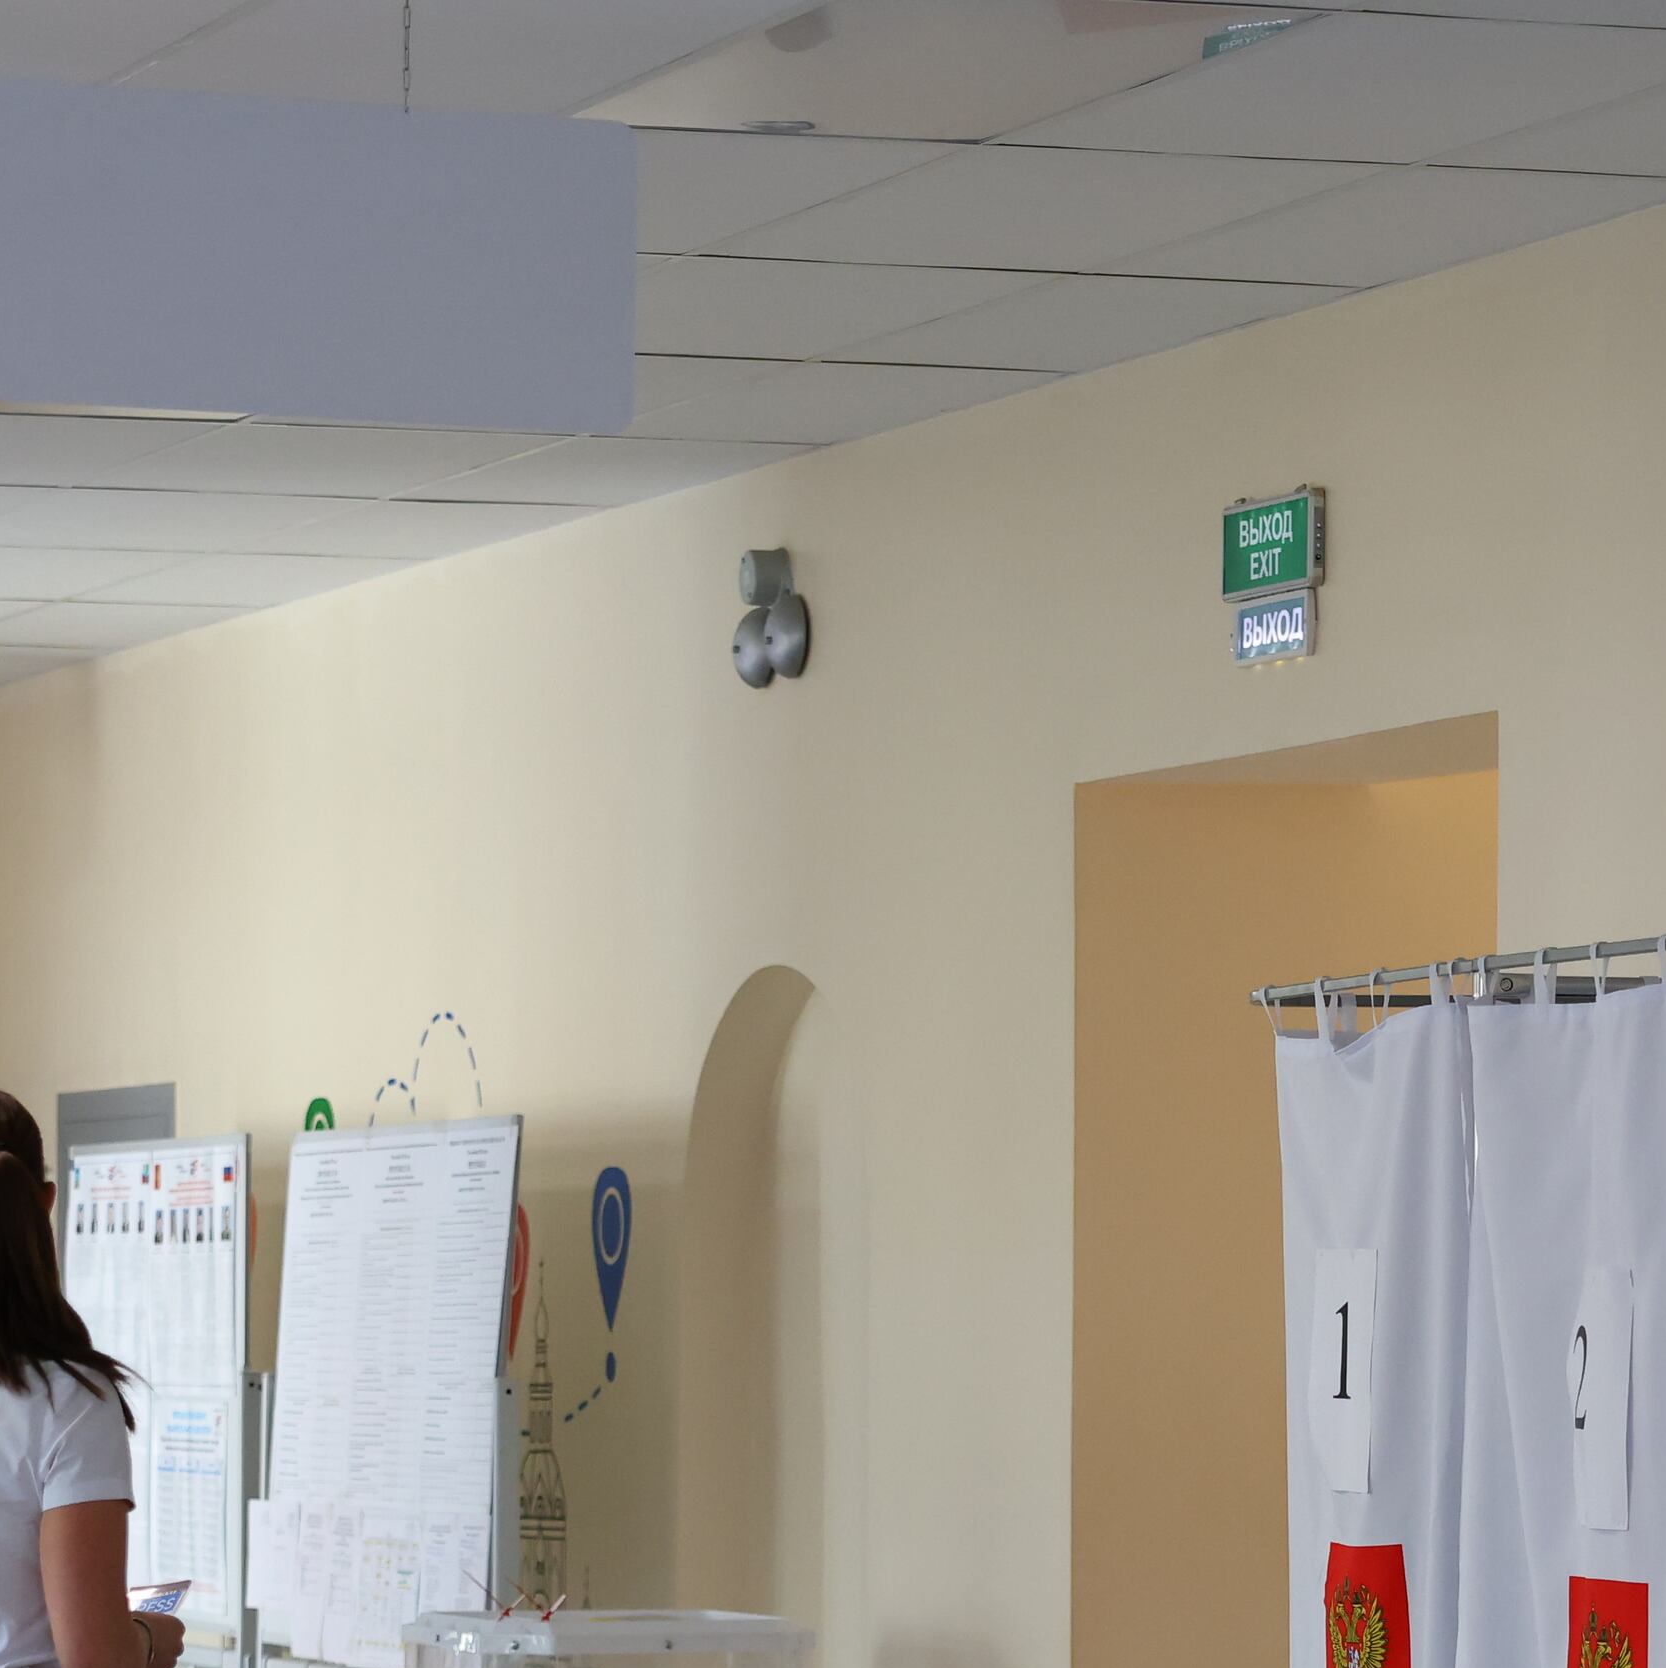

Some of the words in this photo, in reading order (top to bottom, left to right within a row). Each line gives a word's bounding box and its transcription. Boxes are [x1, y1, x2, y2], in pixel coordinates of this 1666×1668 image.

[1239, 510, 1293, 548] ВЫХОД
[1250, 547, 1282, 580] EXIT
[1242, 607, 1304, 649] ВЫХОД
[1332, 1301, 1352, 1399] 1
[1572, 1325, 1587, 1430] 2
